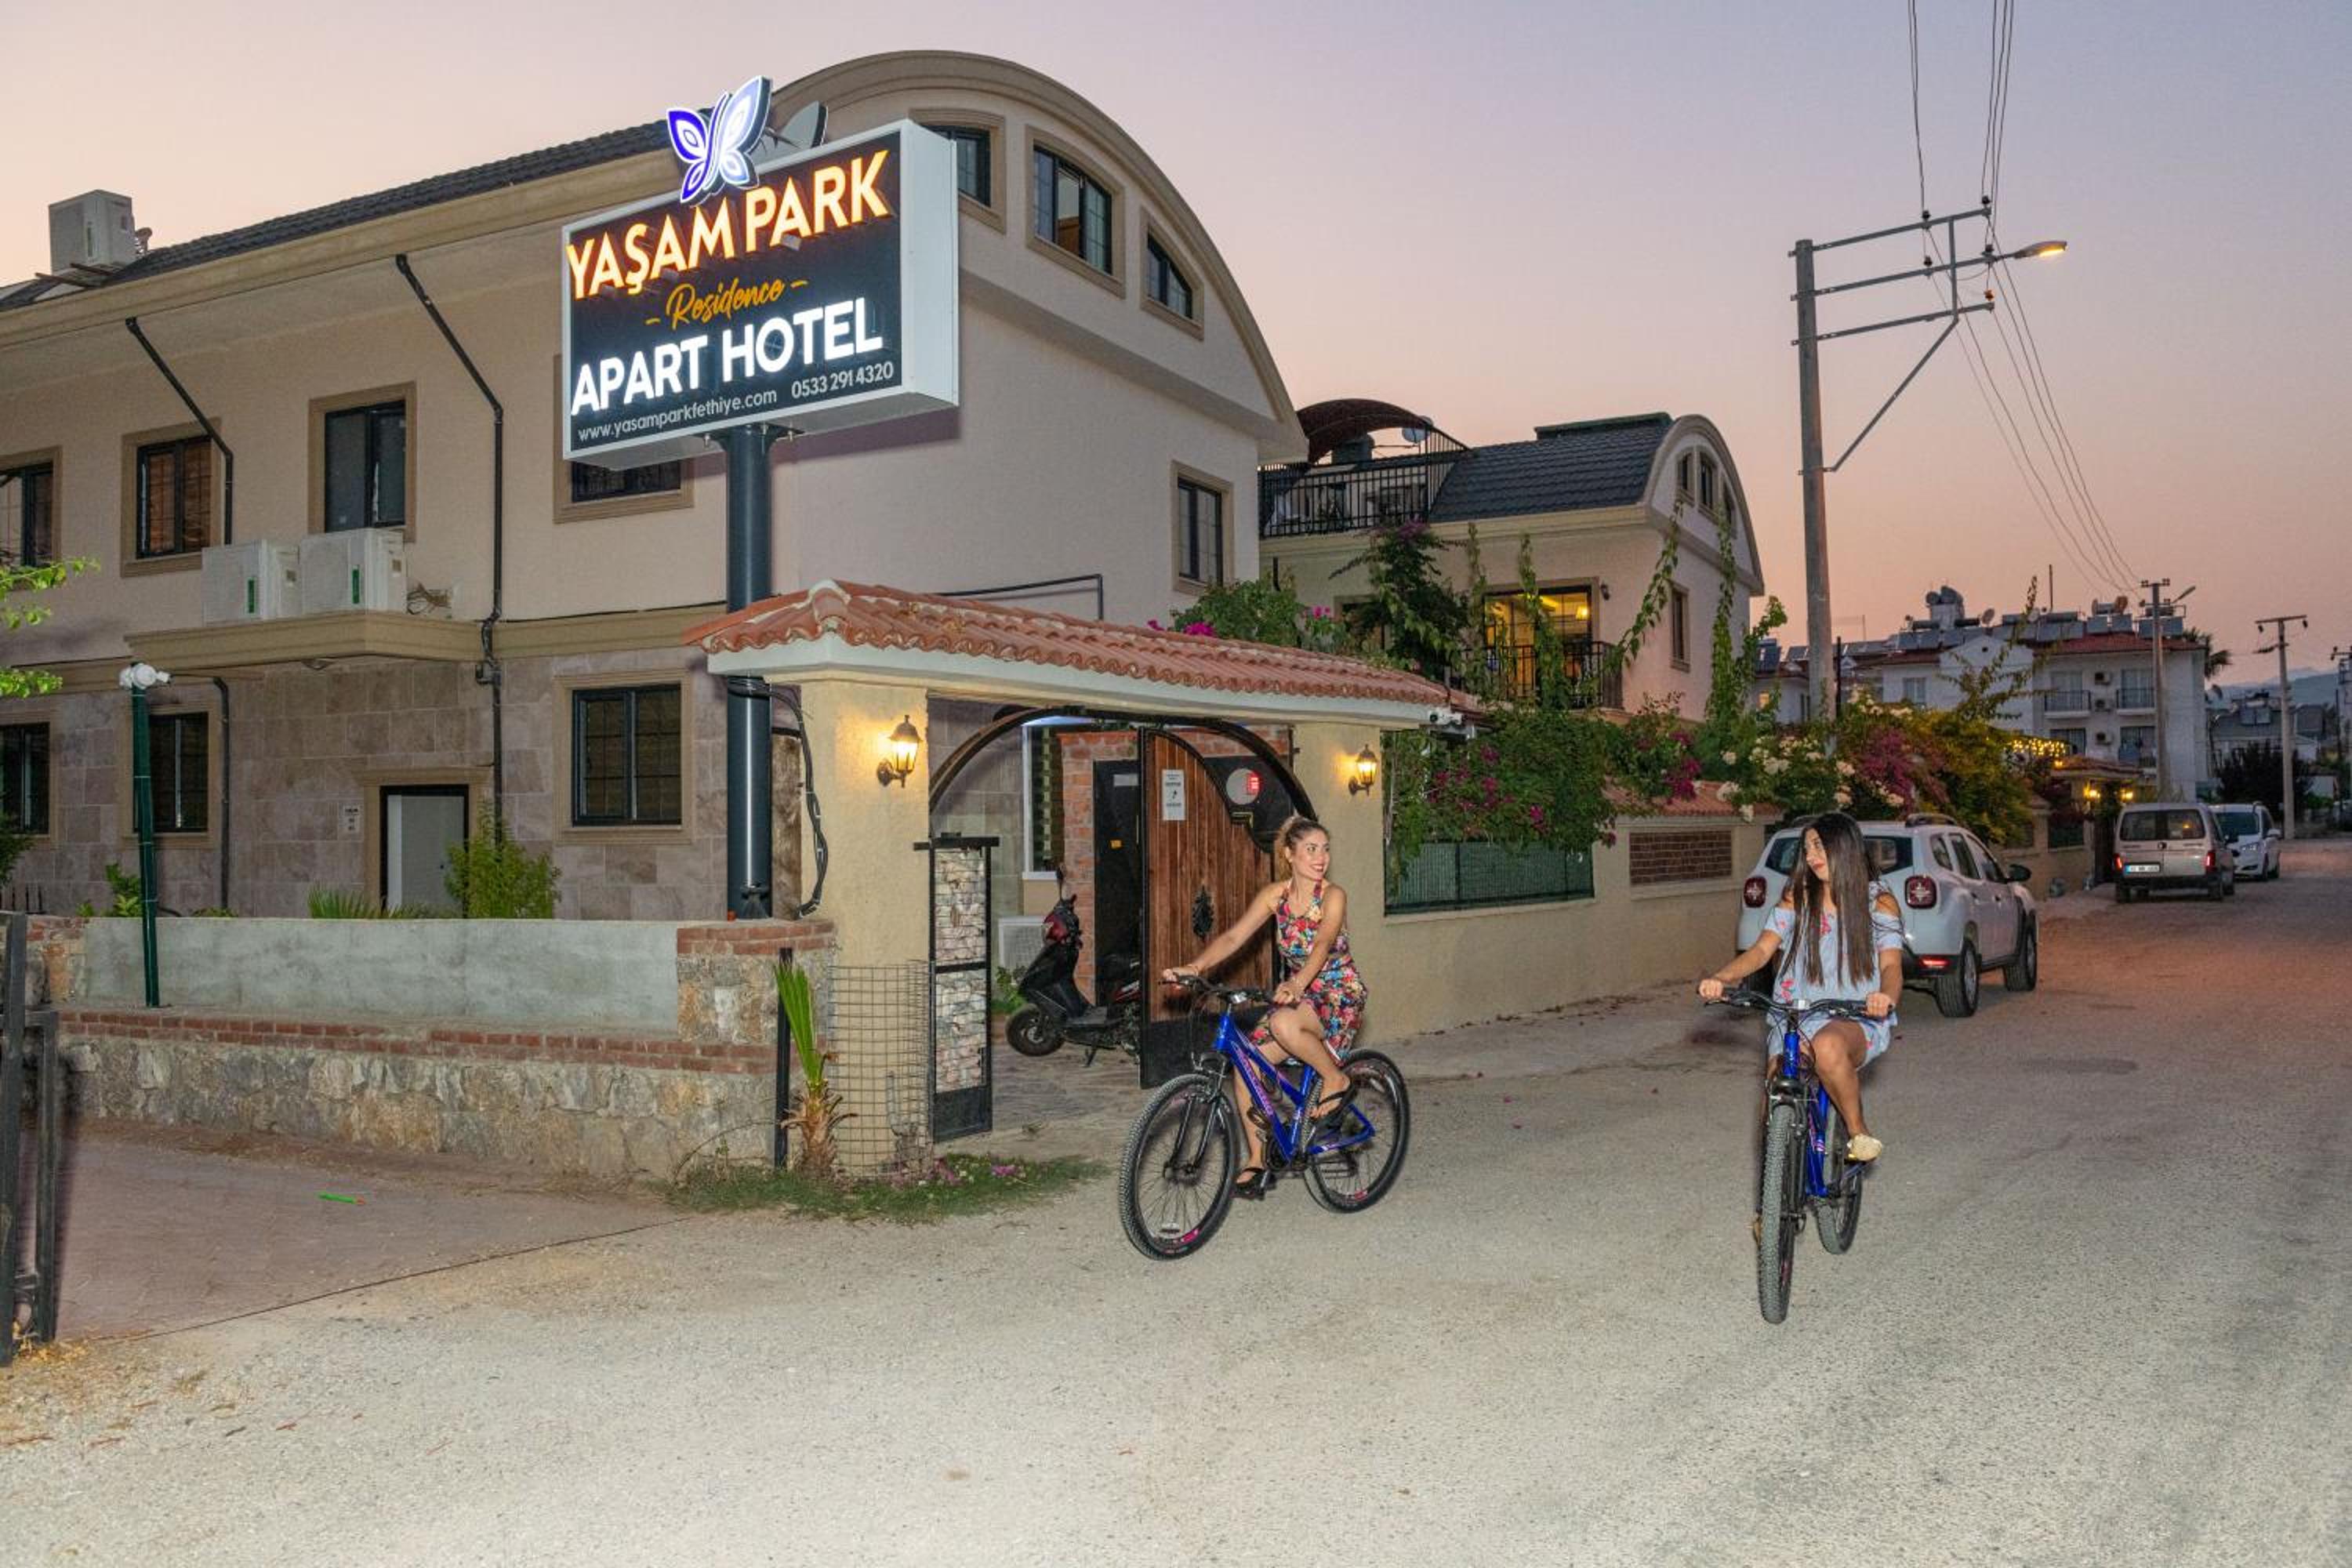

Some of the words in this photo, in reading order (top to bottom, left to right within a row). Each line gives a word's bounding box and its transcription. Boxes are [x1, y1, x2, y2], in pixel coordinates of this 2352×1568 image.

[566, 197, 735, 299] YAŞAM
[746, 150, 891, 252] PARK
[666, 277, 784, 329] Residence
[571, 336, 707, 416] APART
[722, 297, 883, 383] HOTEL
[579, 390, 777, 441] www.yasamparkfethiye.com
[791, 376, 827, 399] 0533
